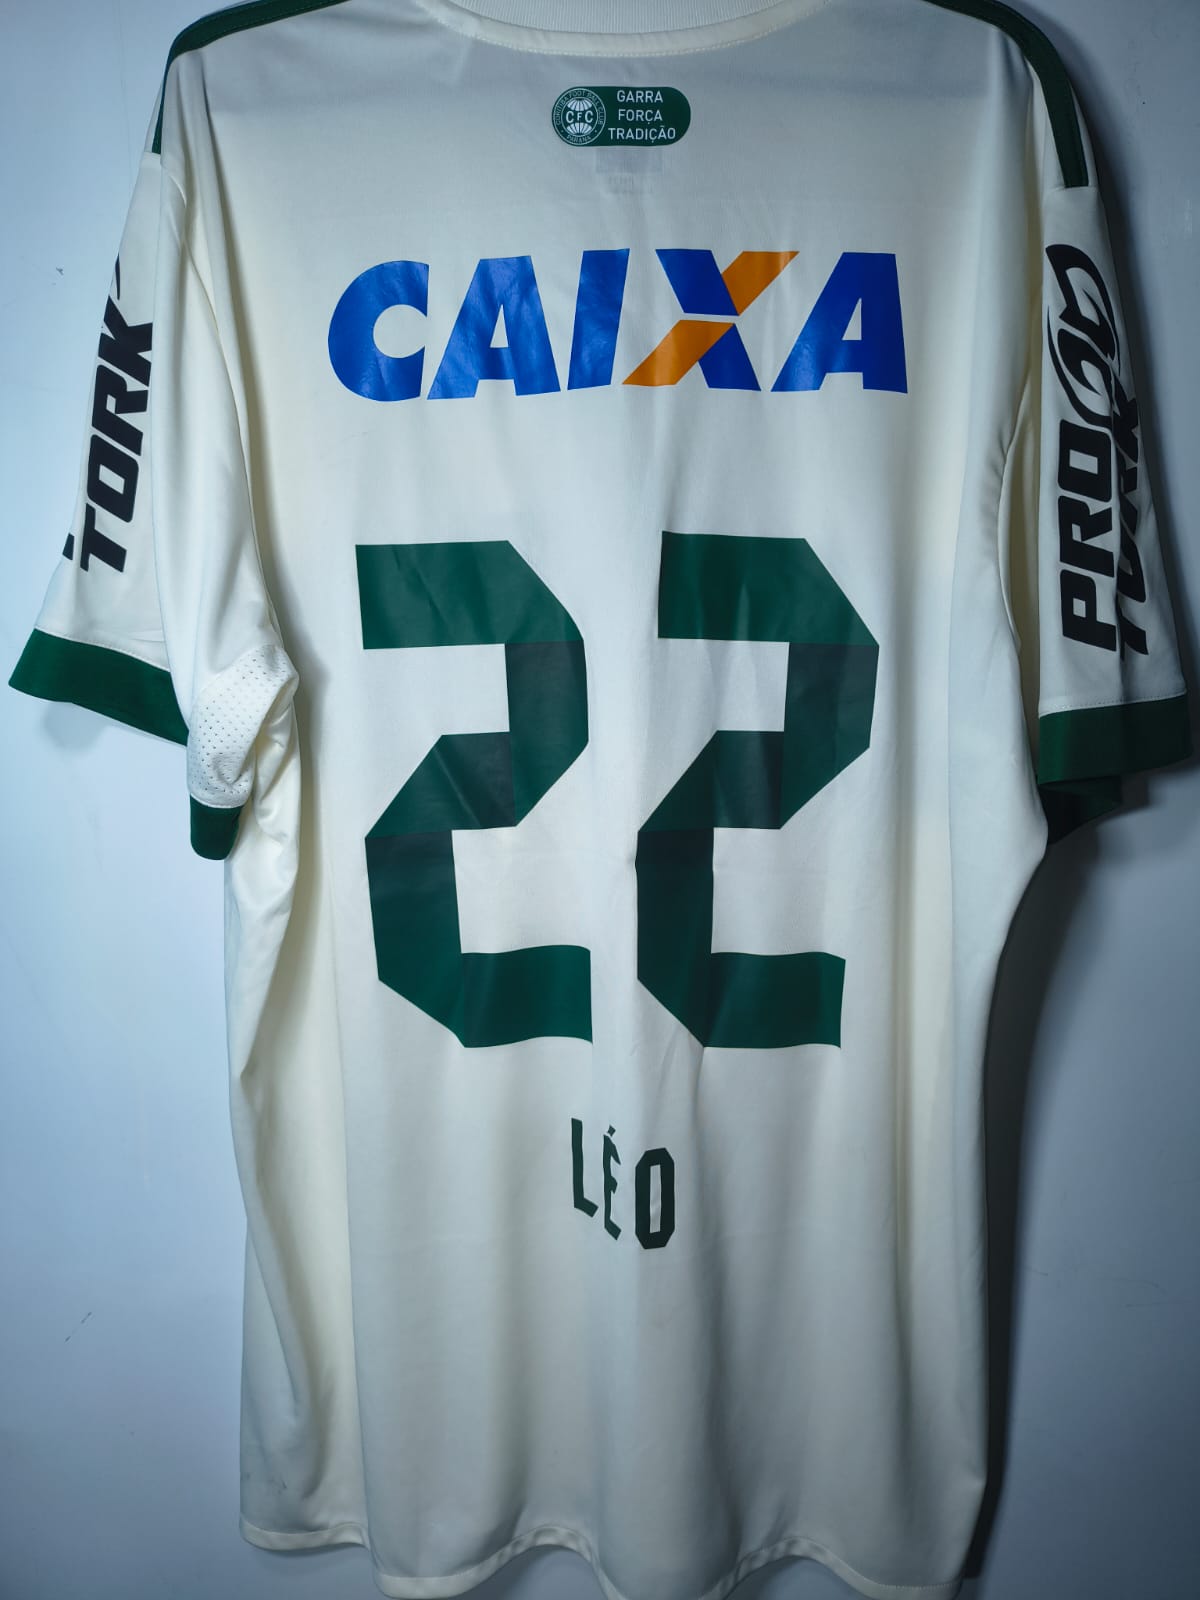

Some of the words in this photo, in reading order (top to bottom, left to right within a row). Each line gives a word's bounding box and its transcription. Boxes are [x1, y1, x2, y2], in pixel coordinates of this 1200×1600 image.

[565, 110, 594, 124] CFC
[608, 125, 676, 143] TRADIÇÃO
[616, 90, 664, 103] GARRA
[618, 109, 663, 125] FORÇA
[328, 248, 907, 402] CAIXA
[80, 295, 153, 573] TORK
[1058, 419, 1117, 652] PRO
[355, 531, 879, 1048] 22
[571, 1117, 676, 1250] LÉO
